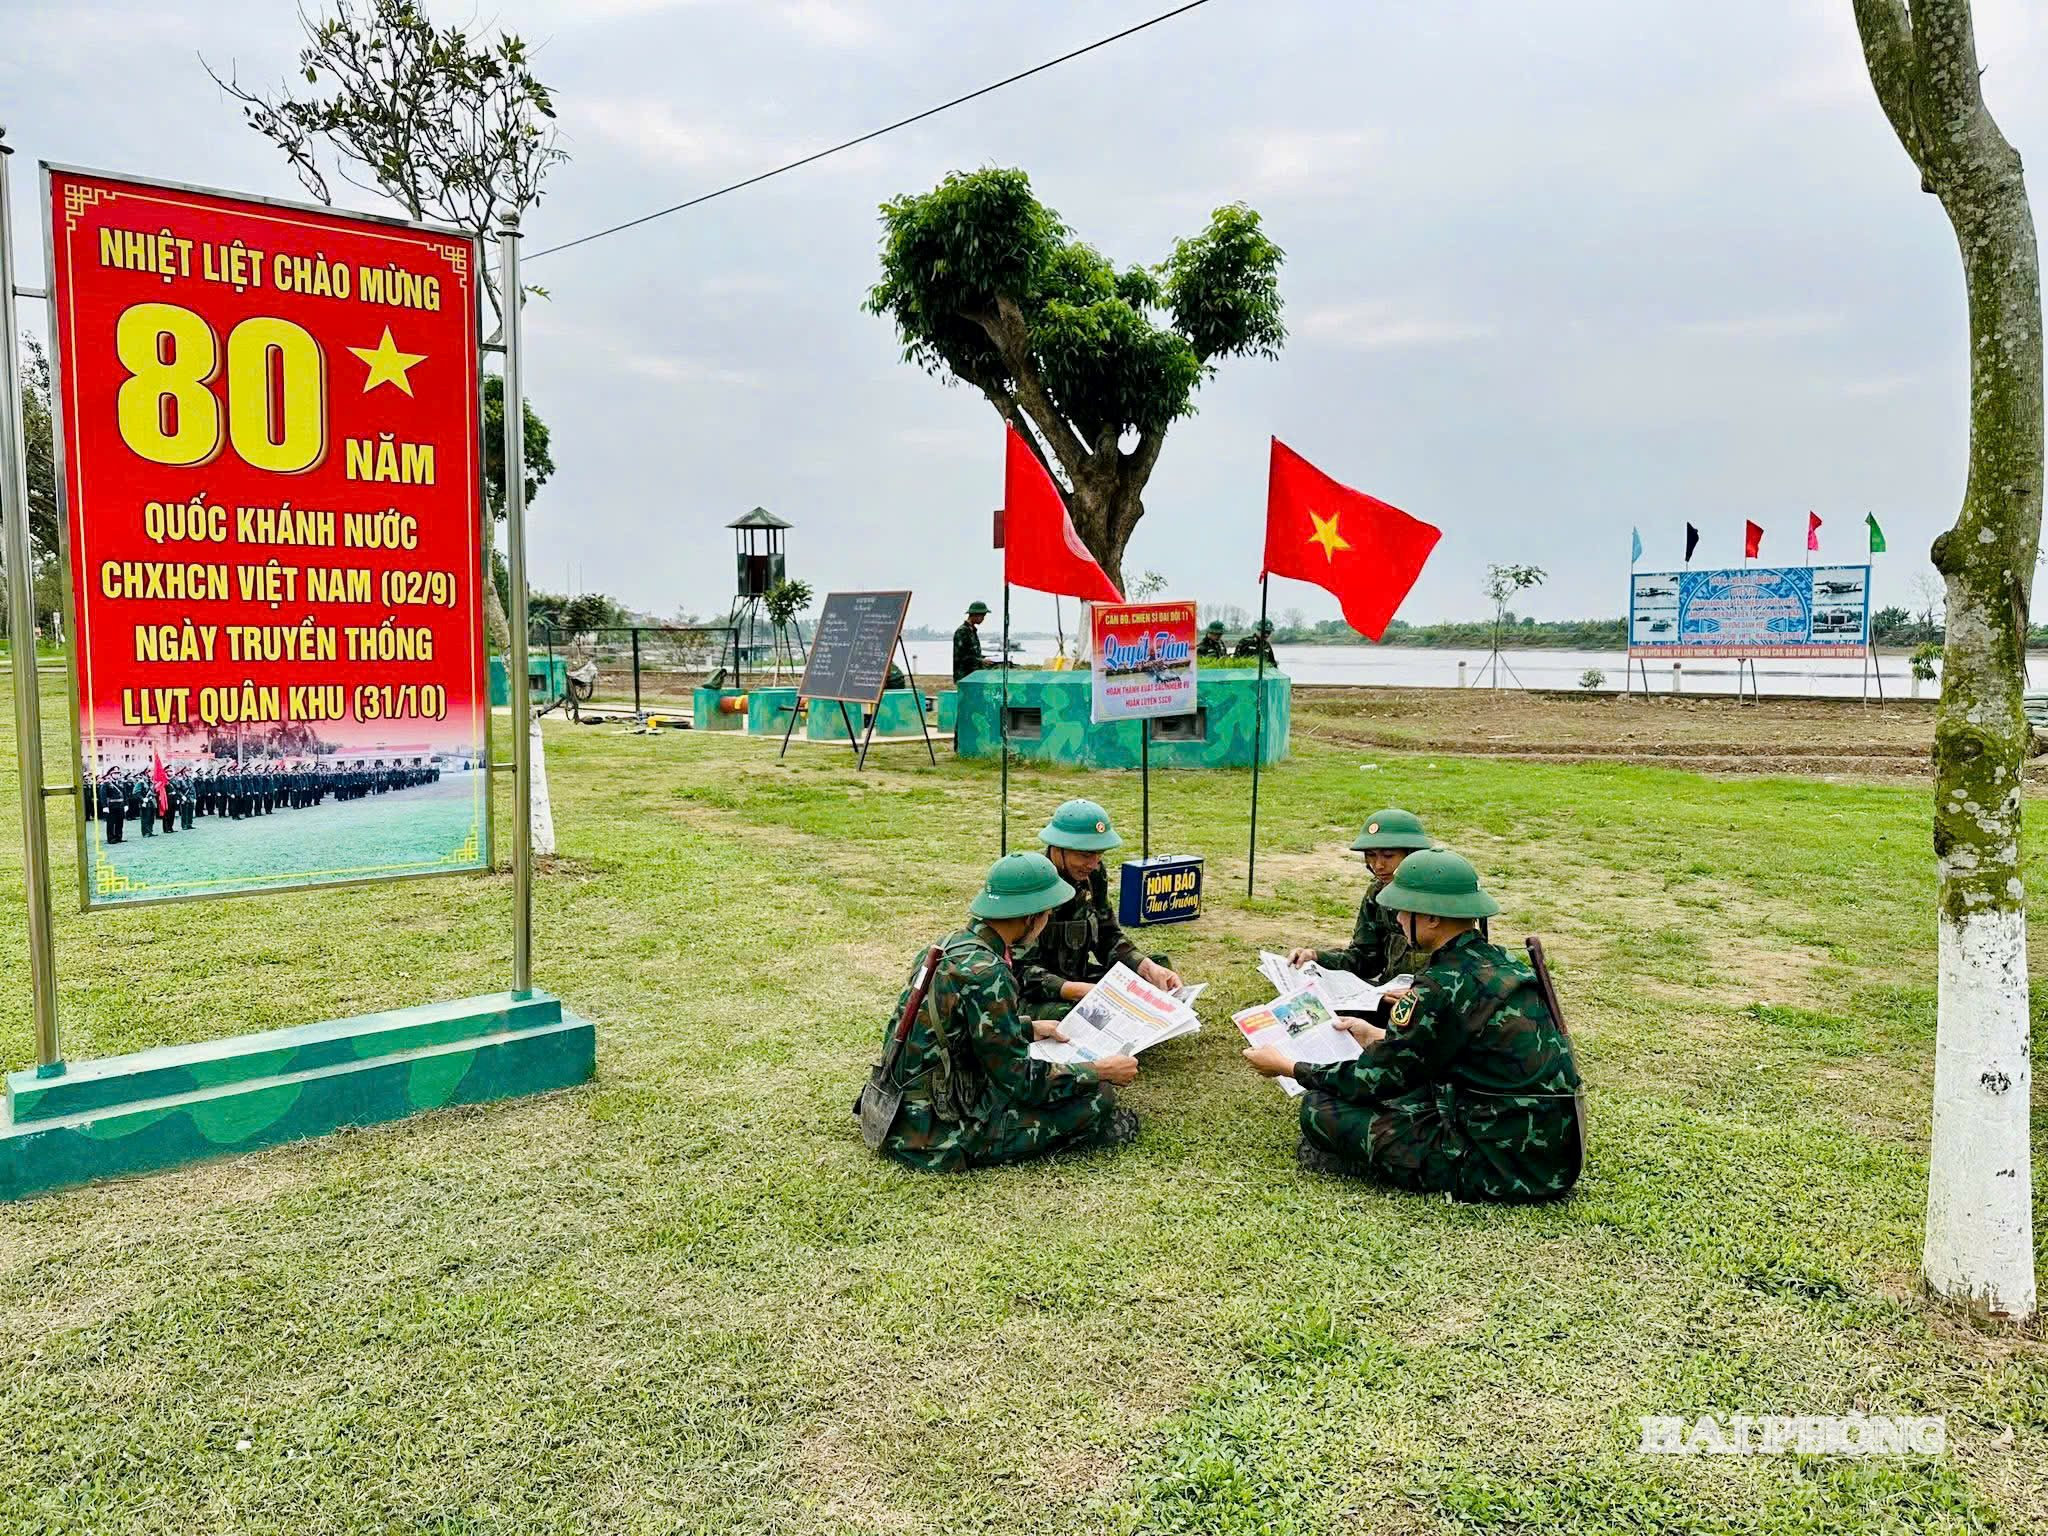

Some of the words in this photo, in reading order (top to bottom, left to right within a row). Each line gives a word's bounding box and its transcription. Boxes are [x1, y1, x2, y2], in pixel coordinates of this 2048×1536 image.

[99, 227, 193, 284] NHIỆT
[202, 240, 264, 293] LIỆT
[272, 252, 350, 299] CHÀO
[359, 263, 440, 311] MỪNG
[116, 302, 328, 475] 80
[345, 432, 435, 485] NĂM
[144, 492, 227, 543] QUỐC
[236, 502, 335, 547] KHÁNH
[343, 508, 418, 550] NƯỚC
[101, 560, 229, 600] CHXHCN
[236, 558, 298, 609] VIỆT
[307, 567, 372, 603] NAM
[381, 570, 456, 608] (02/9)
[135, 617, 218, 661] NGÀY
[226, 615, 336, 661] TRUYỀN
[344, 615, 433, 661] THỐNG
[1104, 631, 1150, 671] Quyết
[122, 687, 189, 726] LLVT
[200, 679, 280, 727] QUÂN
[288, 685, 345, 722] KHU
[354, 683, 446, 723] (31/10)
[1146, 872, 1172, 896] HÒM
[1174, 868, 1196, 892] BÁO
